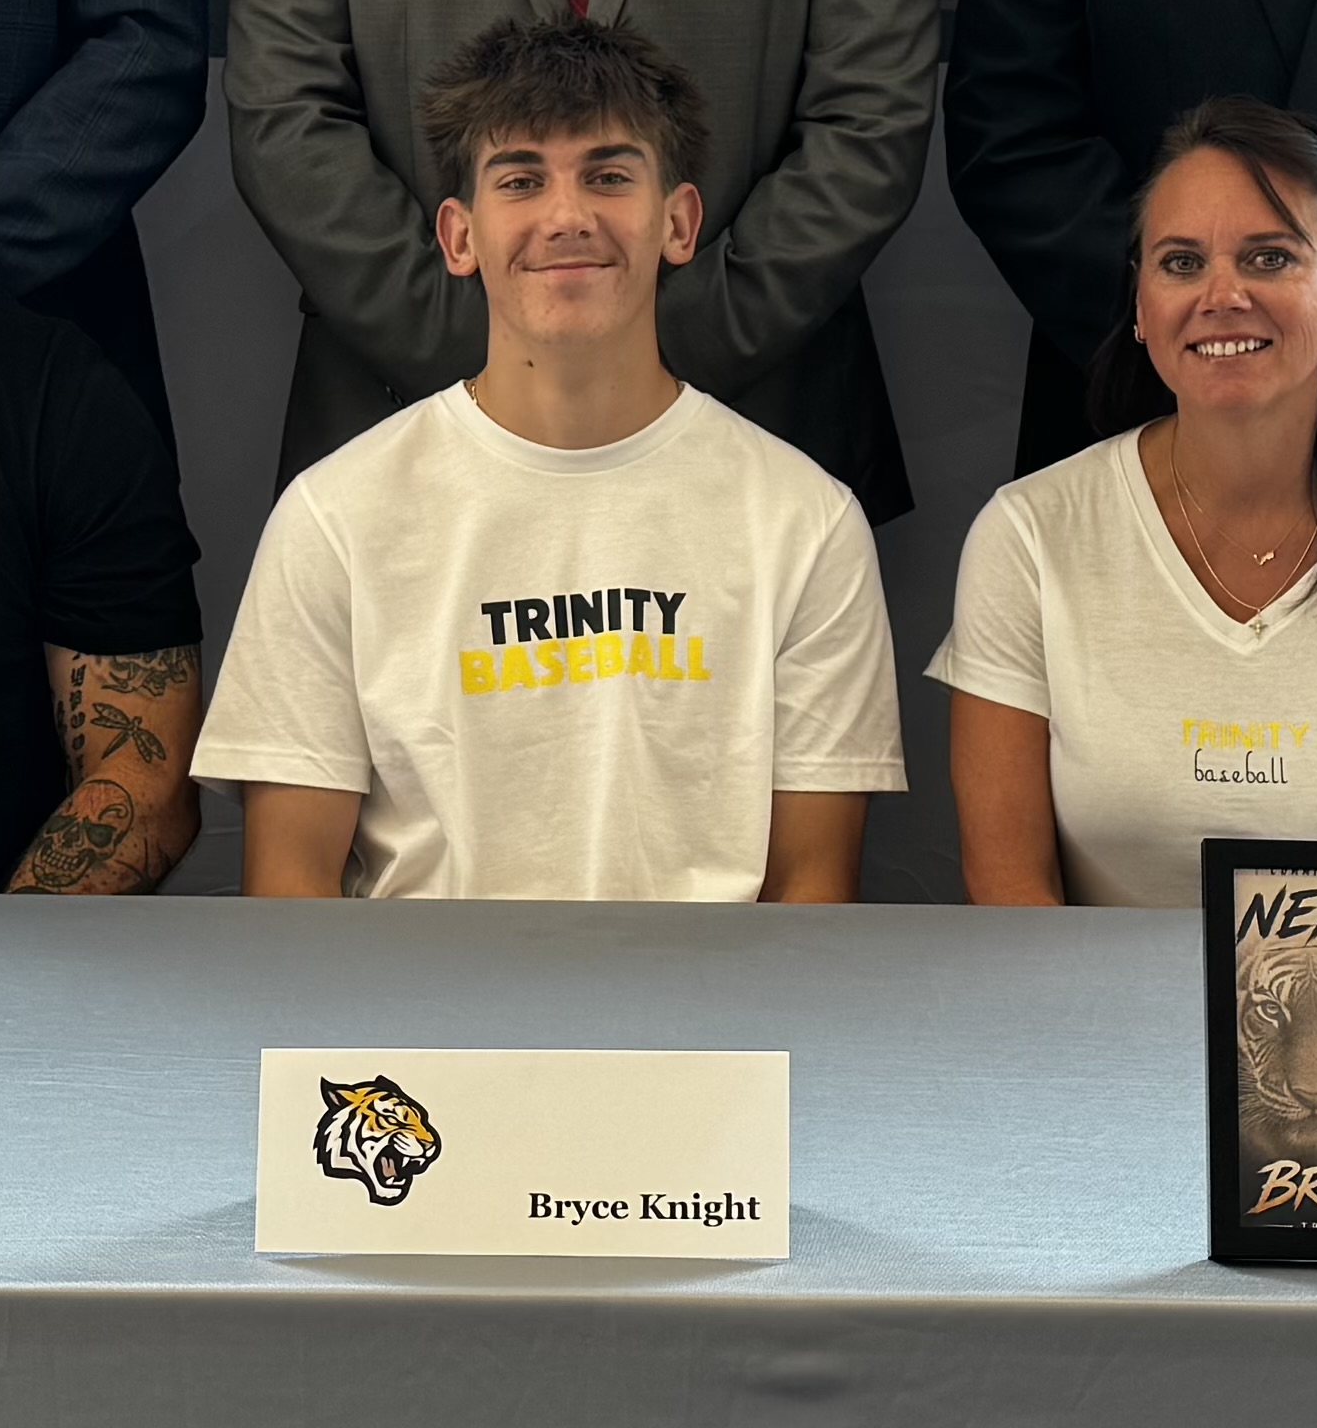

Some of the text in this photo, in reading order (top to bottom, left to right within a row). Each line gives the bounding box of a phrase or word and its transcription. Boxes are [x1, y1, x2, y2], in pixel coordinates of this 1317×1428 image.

[480, 588, 687, 645] TRINITY
[458, 633, 713, 695] BASEBALL
[1181, 718, 1311, 749] TRINITY
[1194, 748, 1289, 784] baseball
[528, 1192, 761, 1228] Bryce Knight
